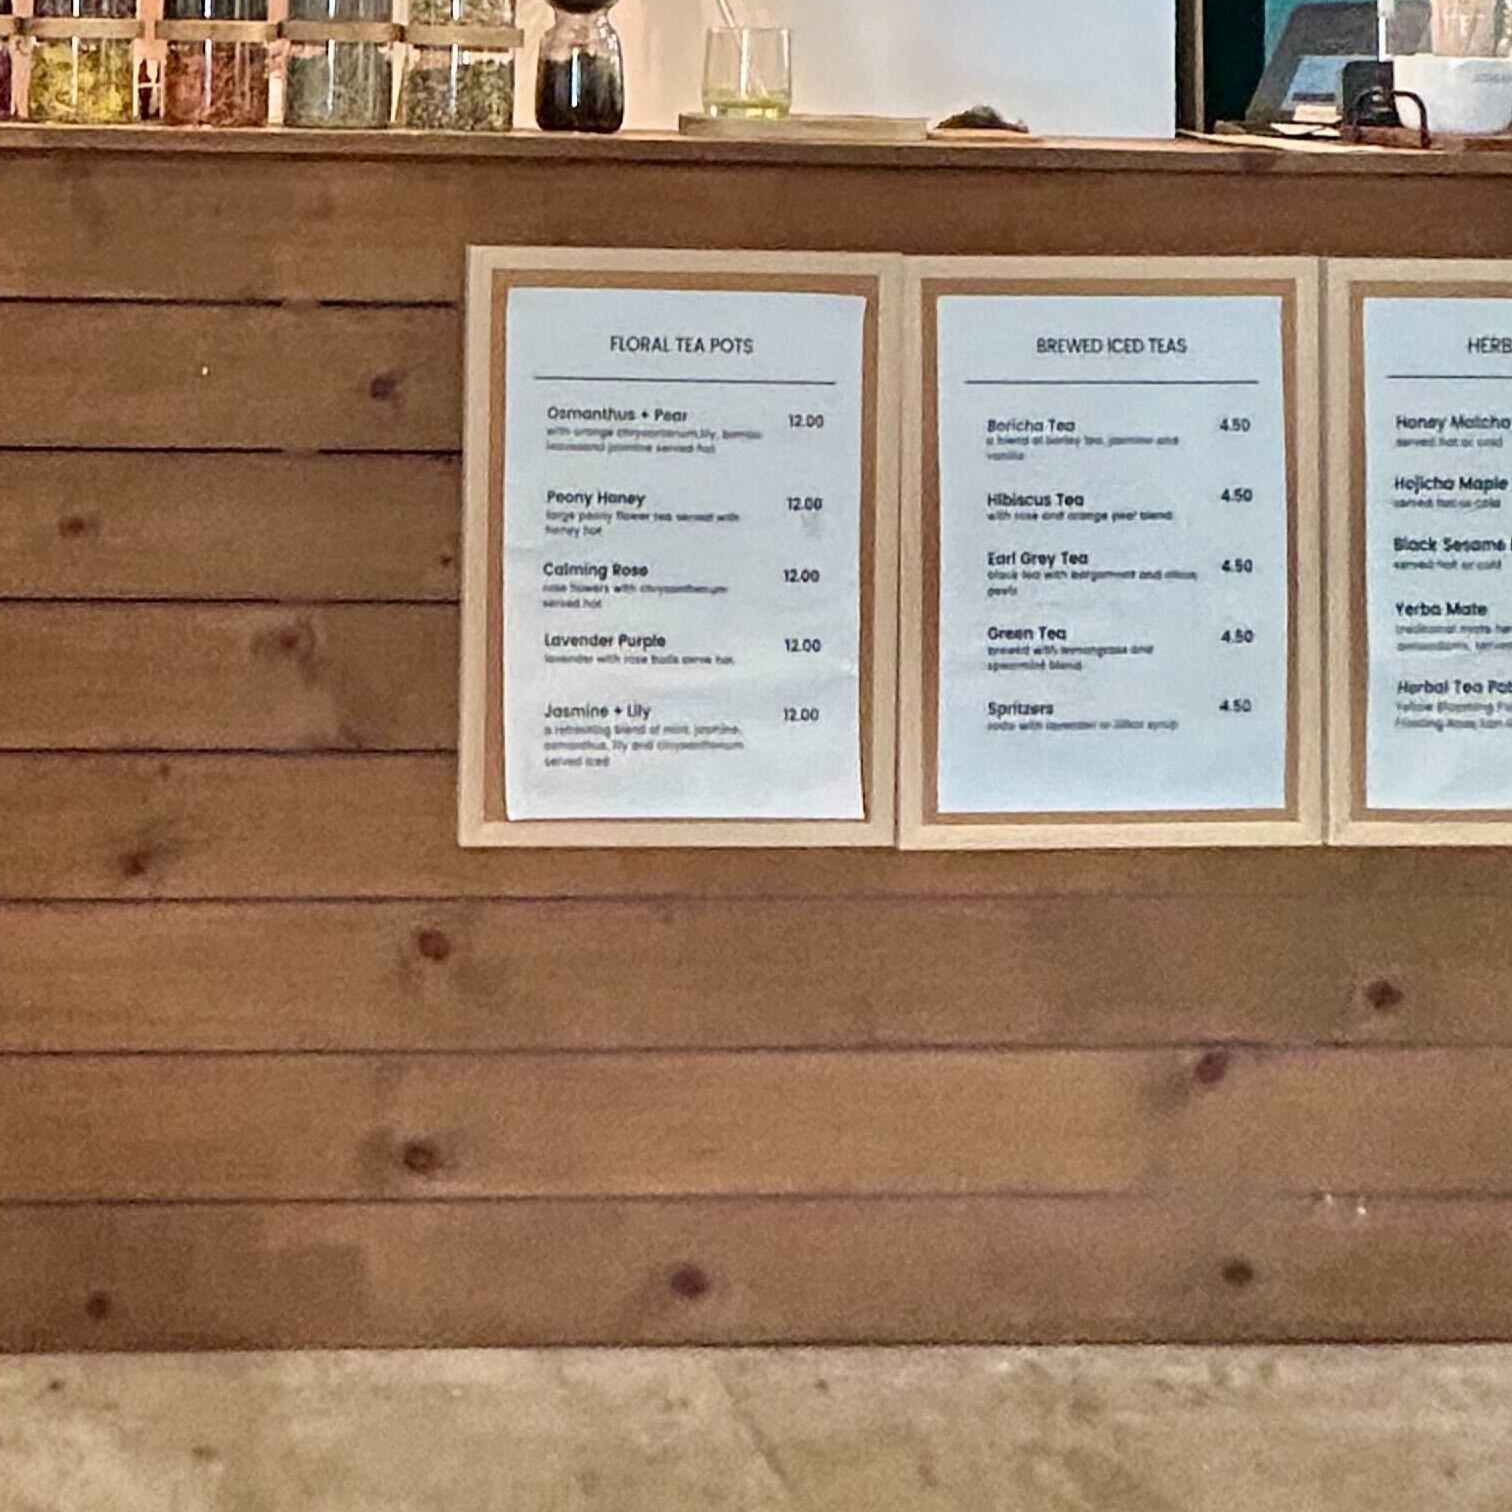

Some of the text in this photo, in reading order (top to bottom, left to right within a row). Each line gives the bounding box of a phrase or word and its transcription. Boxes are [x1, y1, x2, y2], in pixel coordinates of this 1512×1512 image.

[609, 335, 754, 355] FLORAL TEA POTS
[1036, 337, 1188, 354] BREWED ICED TEAS
[1467, 337, 1512, 354] HERB
[546, 405, 636, 422] Osmanthus
[654, 408, 689, 422] Pear
[788, 413, 825, 429] 12.00
[987, 418, 1076, 433] Boricha Tea
[1219, 418, 1251, 433] 4.50
[1396, 414, 1511, 433] Honey Matcha
[1394, 475, 1509, 495] Hojicha Maple
[546, 489, 646, 508] Peony Honey
[987, 492, 1085, 507] Hibiscus Tea
[1220, 488, 1253, 503] 4.50
[787, 497, 823, 512] 12.00
[1393, 537, 1506, 552] Black Sesame
[987, 551, 1089, 568] Earl Grey Tea
[1221, 558, 1253, 574] 4.50
[542, 562, 649, 581] Calming Rose
[783, 568, 821, 584] 12.00
[1395, 601, 1488, 616] Yerba Mate
[544, 632, 666, 651] Lavender Purple
[987, 626, 1067, 641] Green Tea
[1221, 629, 1254, 644] 4.50
[784, 638, 822, 654] 12.00
[1397, 680, 1449, 694] Herbal
[1454, 680, 1484, 694] Tea
[544, 703, 609, 719] Jasmine
[626, 703, 652, 720] Lily
[987, 701, 1054, 719] Spritzers
[1219, 698, 1252, 714] 4.50
[783, 707, 820, 723] 12.00
